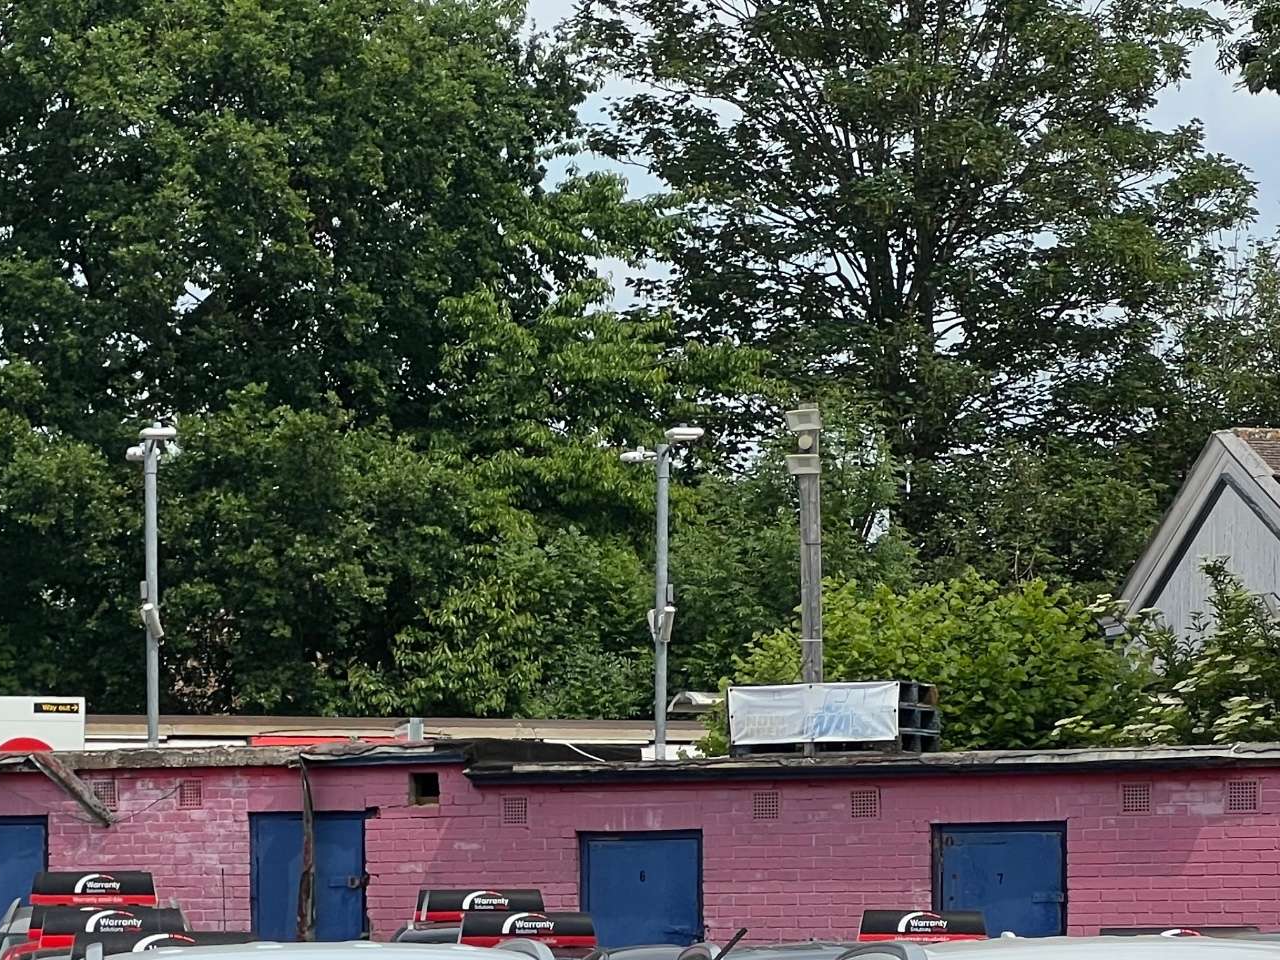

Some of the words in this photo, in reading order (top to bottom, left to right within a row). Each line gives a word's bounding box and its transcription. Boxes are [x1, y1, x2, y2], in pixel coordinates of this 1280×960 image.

[42, 703, 58, 712] Way
[85, 881, 121, 890] Warranty
[474, 897, 509, 907] Warranty
[99, 918, 143, 928] Warranty
[515, 920, 555, 931] Warranty
[909, 919, 948, 928] Warranty
